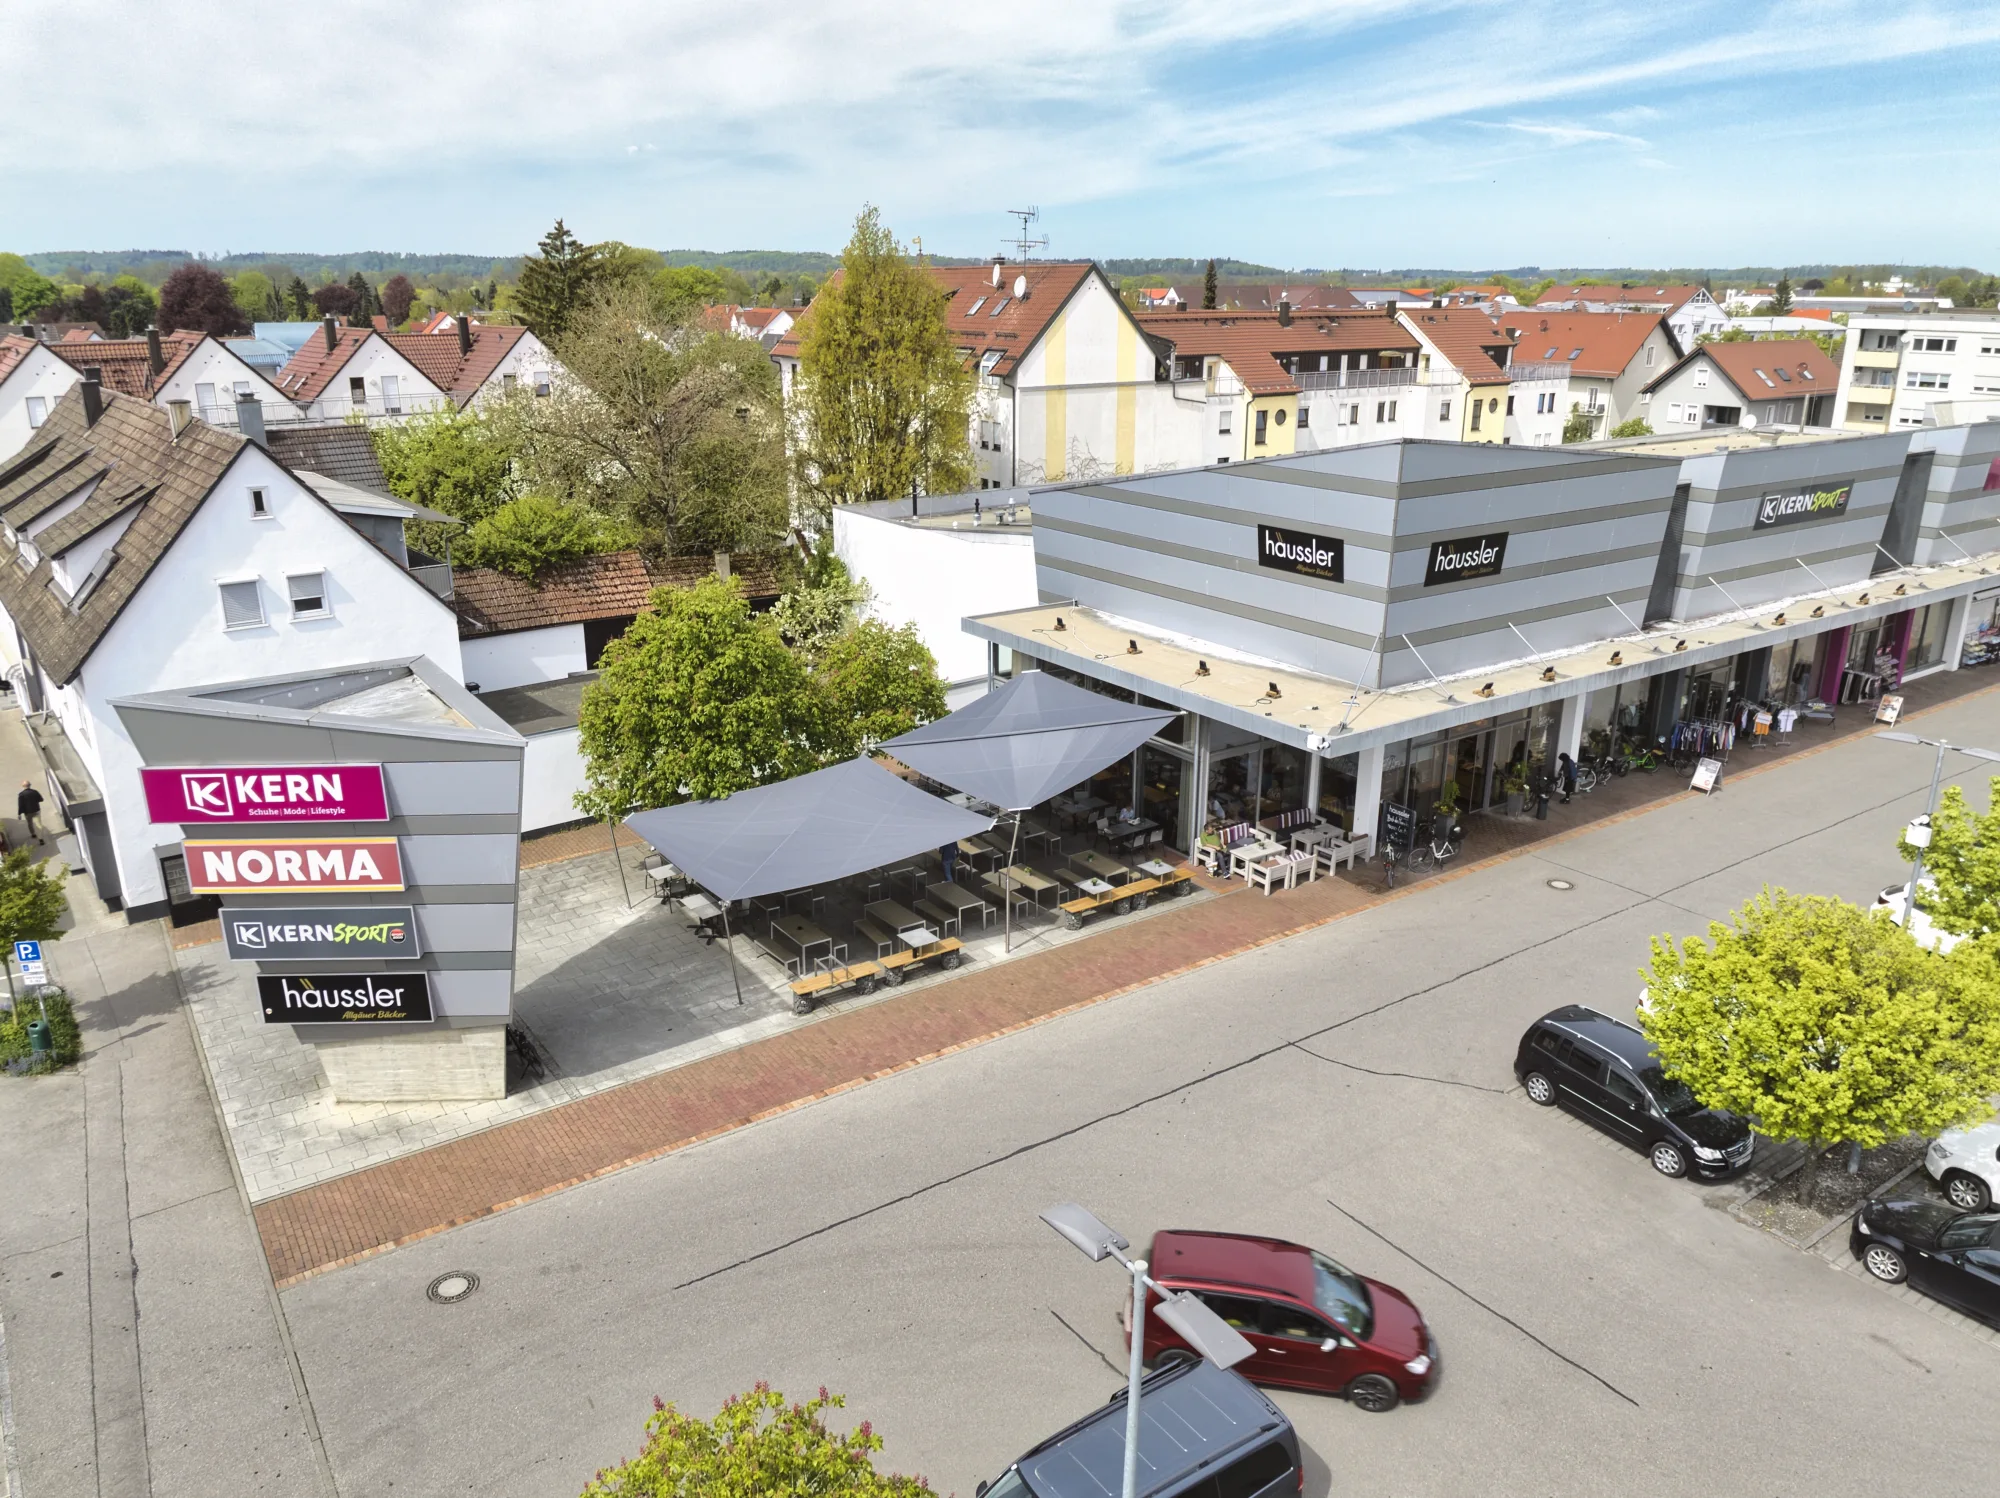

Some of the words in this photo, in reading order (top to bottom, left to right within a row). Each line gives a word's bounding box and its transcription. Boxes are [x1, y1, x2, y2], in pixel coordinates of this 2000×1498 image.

[1265, 530, 1335, 567] häussler
[1435, 540, 1499, 572] häussler
[234, 774, 344, 803] KERN
[248, 808, 279, 816] Schuhe
[283, 808, 306, 816] Mode
[310, 807, 346, 816] Lifestyle
[202, 849, 383, 883] NORMA
[19, 944, 32, 959] P
[281, 977, 405, 1008] häussler
[341, 1010, 376, 1021] Allgäuer
[377, 1010, 407, 1019] Bäcker
